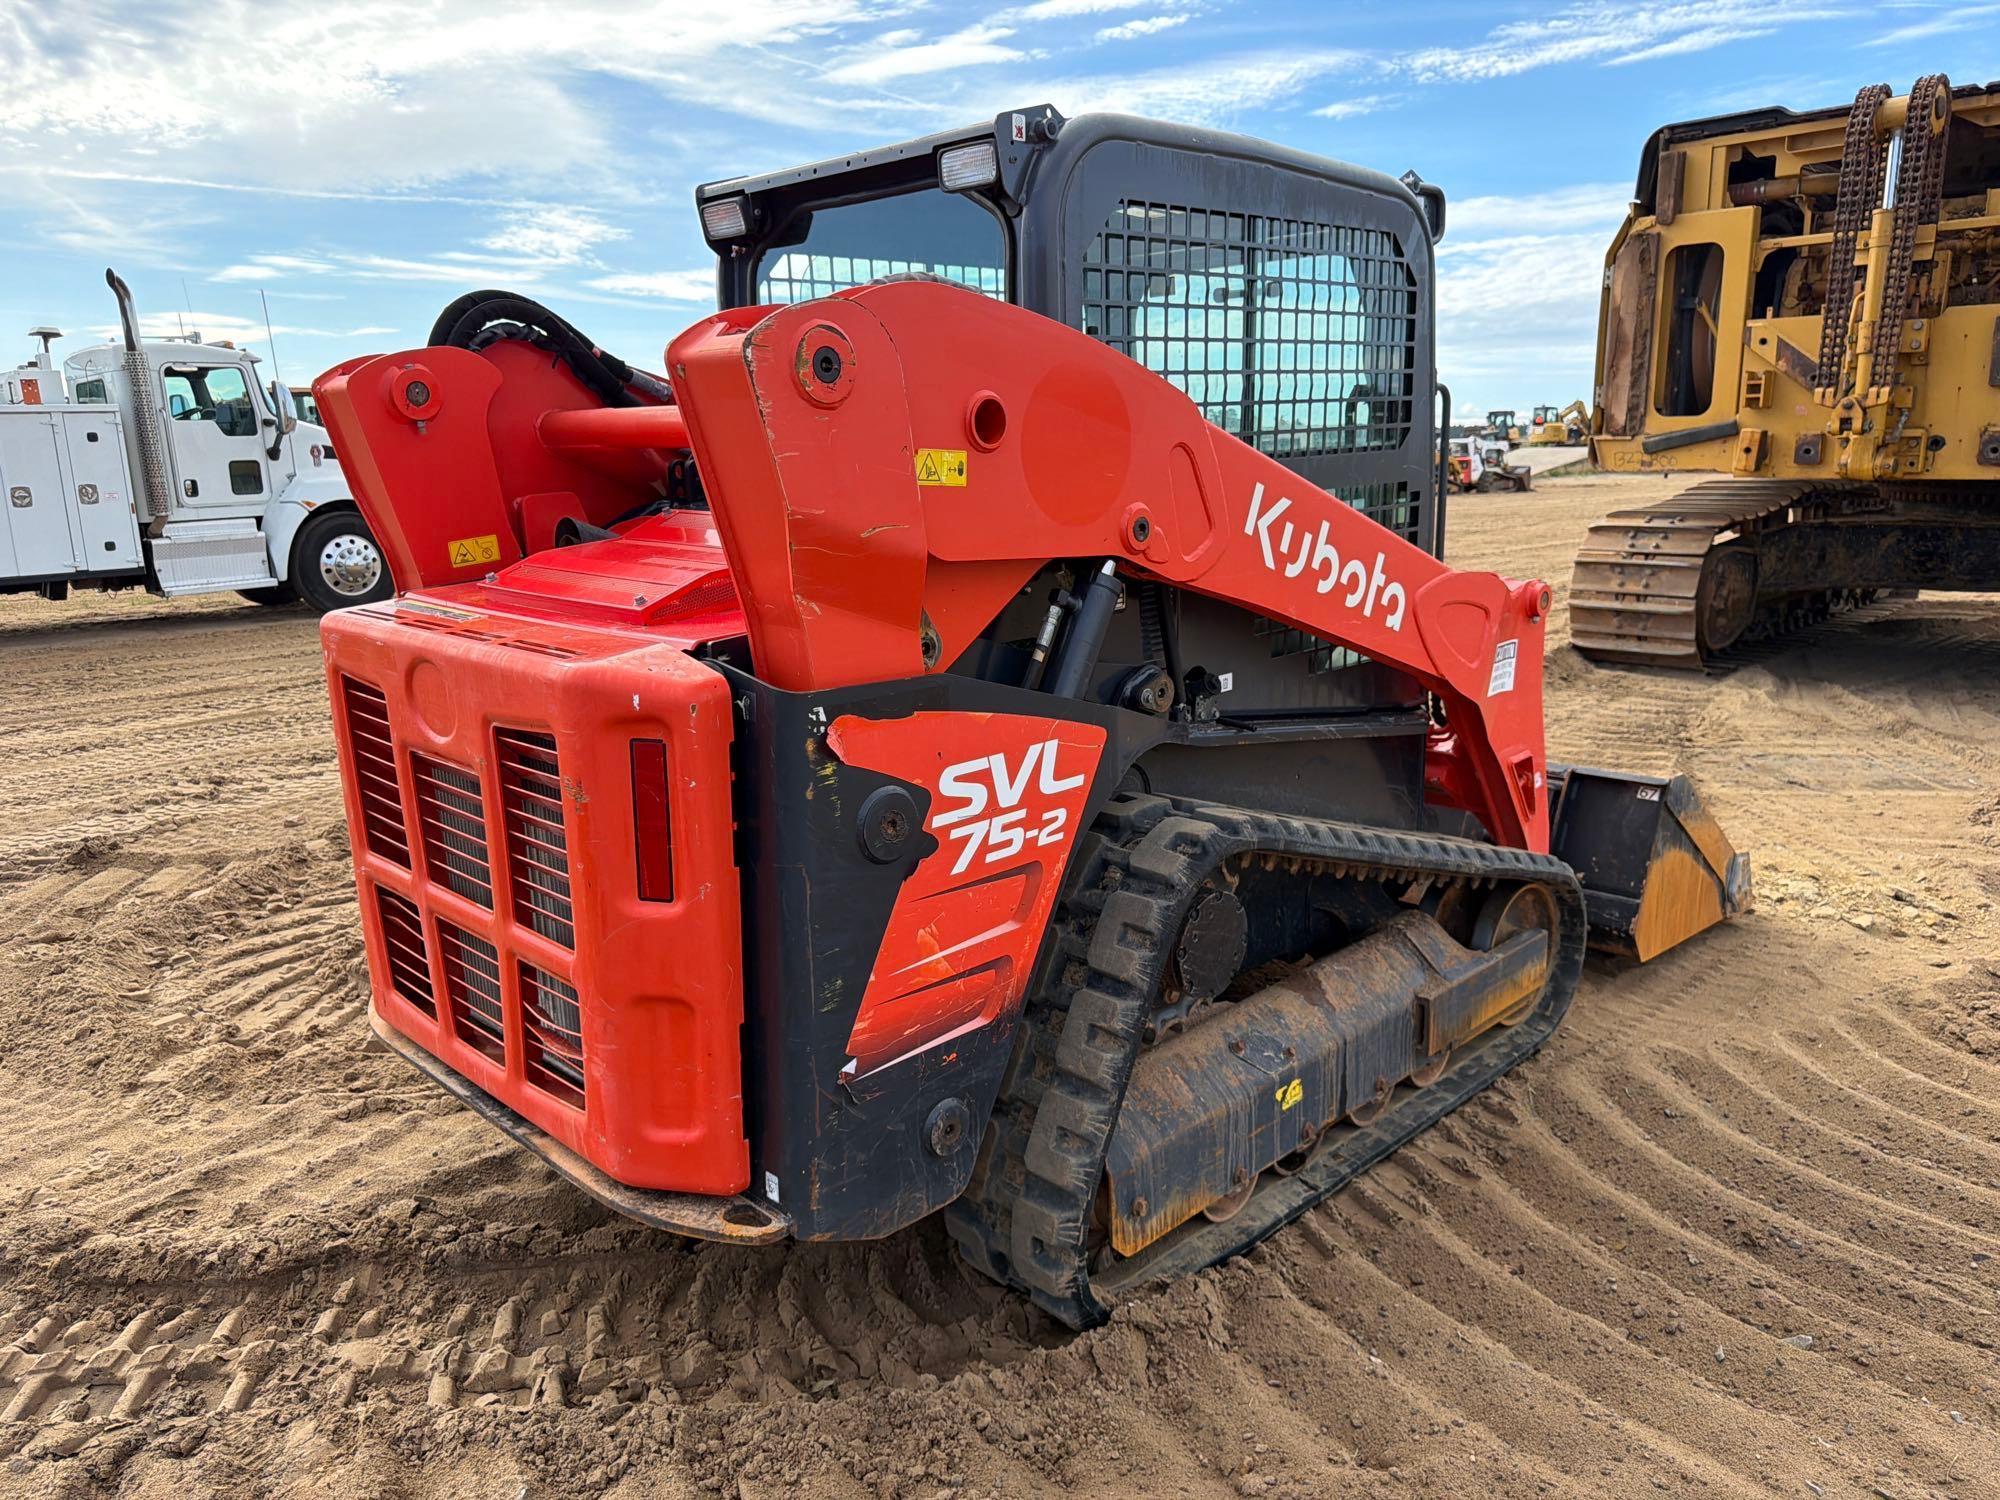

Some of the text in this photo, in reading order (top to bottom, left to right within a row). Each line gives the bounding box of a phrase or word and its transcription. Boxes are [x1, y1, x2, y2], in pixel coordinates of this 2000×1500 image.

[1244, 482, 1406, 632] Kubota
[931, 739, 1086, 829] SVL
[1639, 786, 1659, 800] 67
[949, 807, 1067, 876] 75-2
